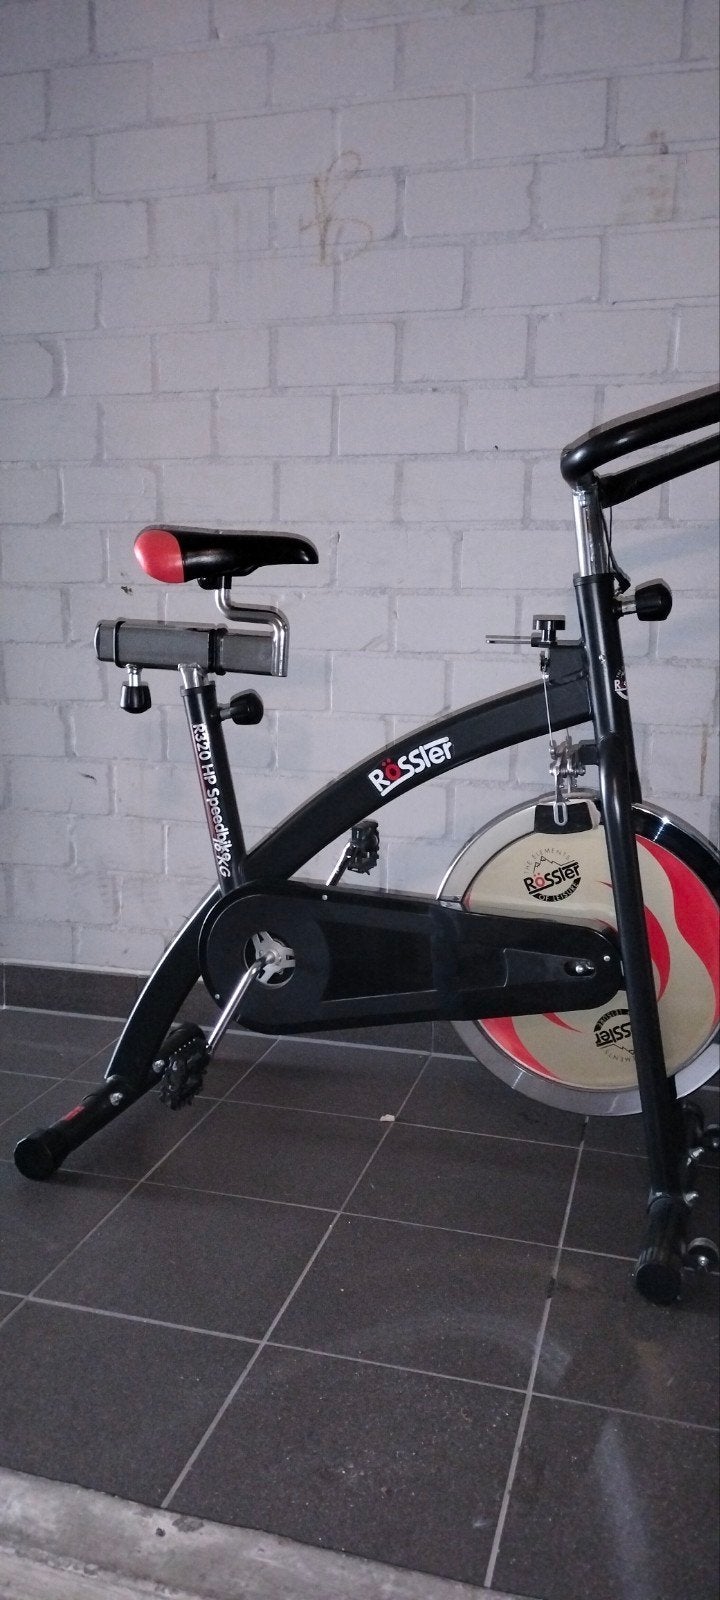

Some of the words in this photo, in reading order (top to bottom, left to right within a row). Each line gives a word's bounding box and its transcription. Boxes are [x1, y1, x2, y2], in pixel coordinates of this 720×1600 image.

[193, 723, 211, 760] R320
[202, 763, 217, 785] HP
[206, 787, 232, 862] Speedbike
[216, 855, 231, 877] KG
